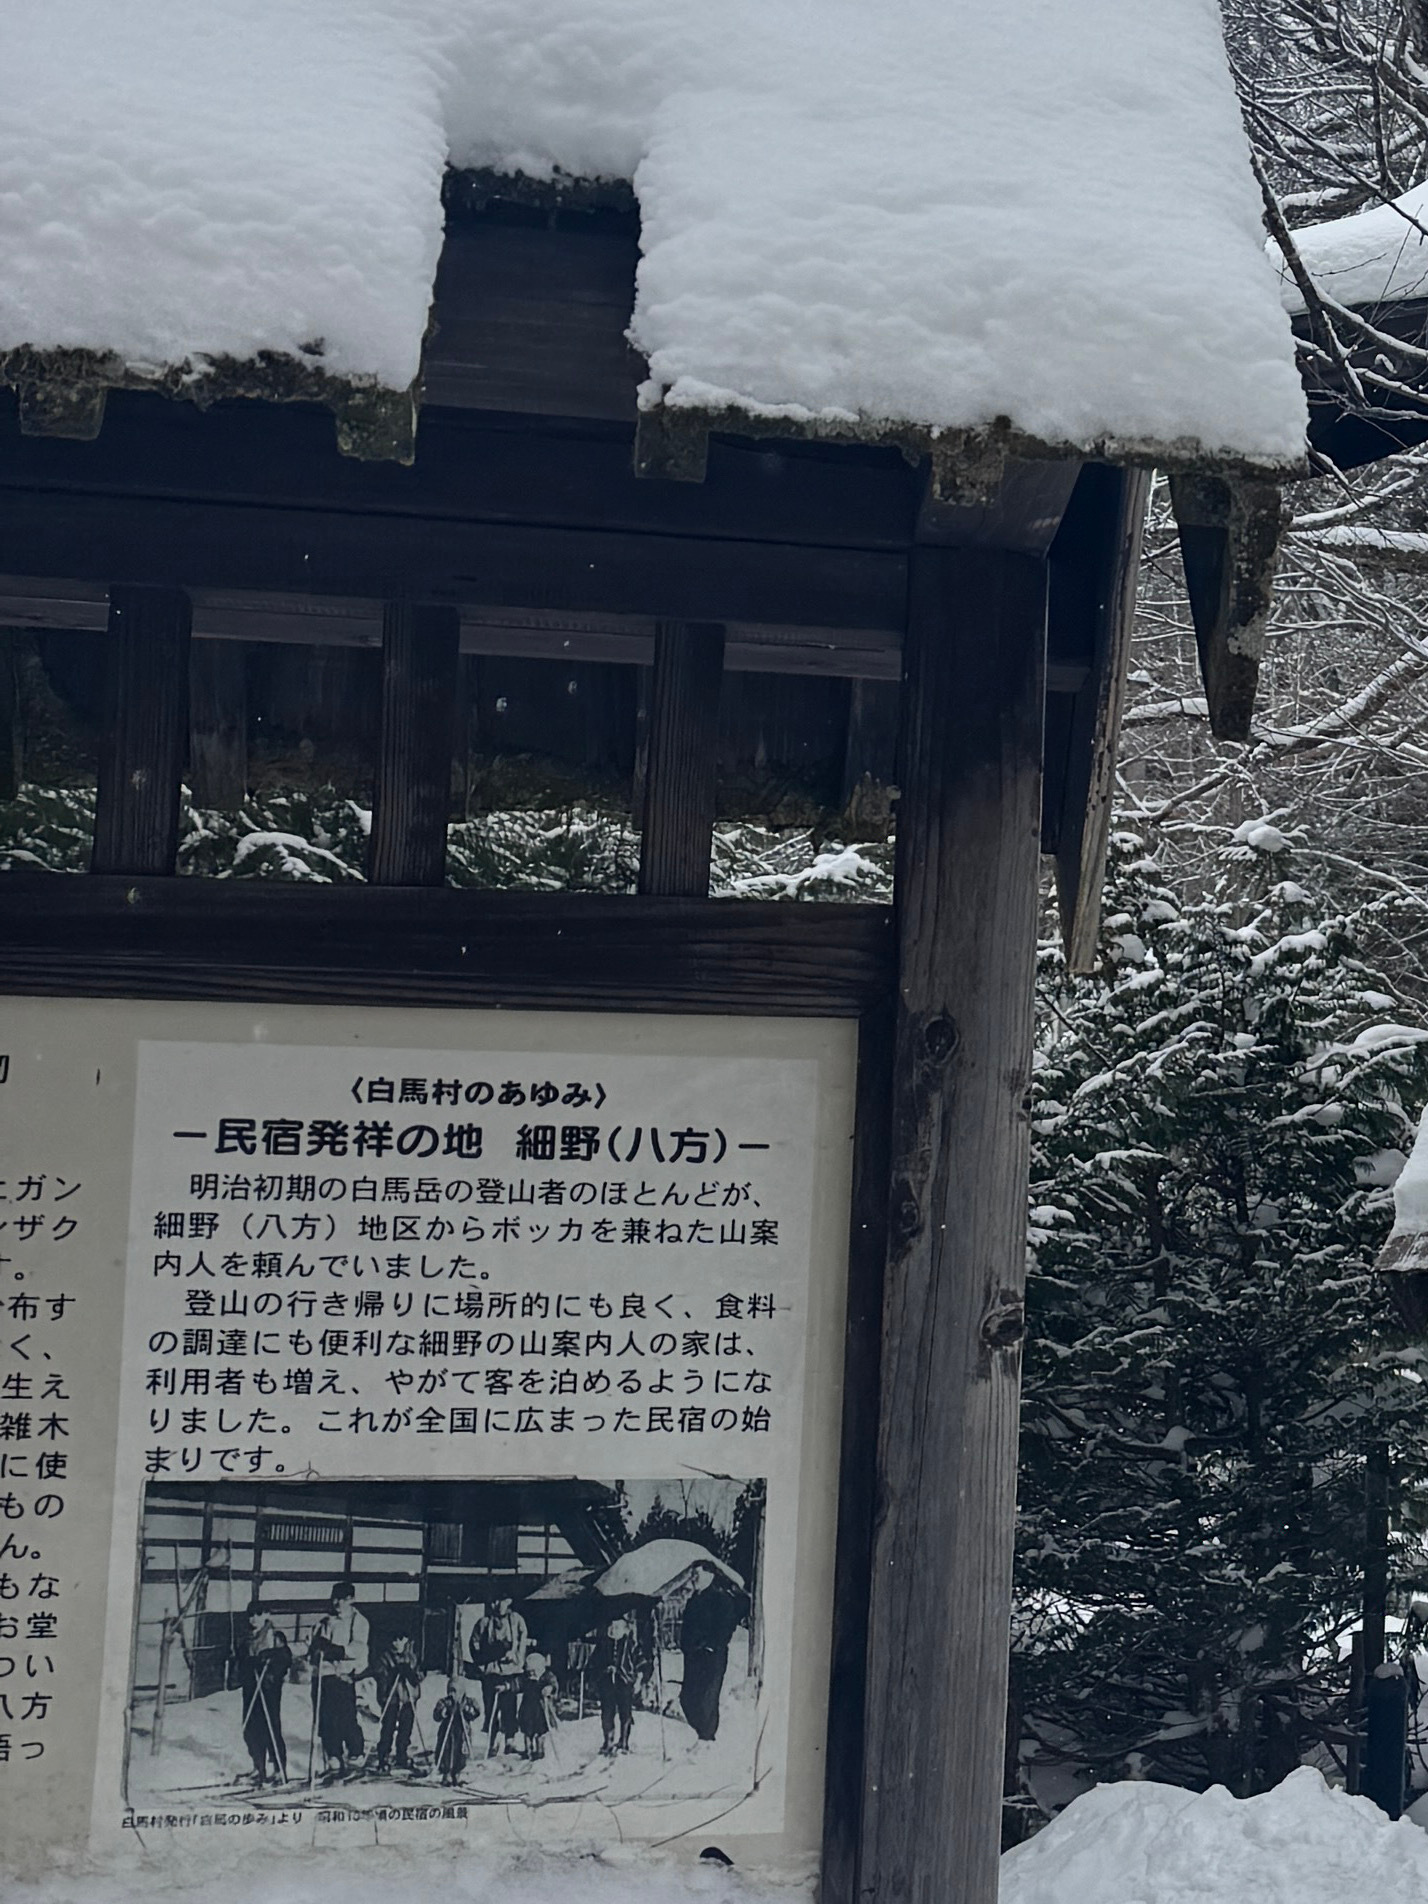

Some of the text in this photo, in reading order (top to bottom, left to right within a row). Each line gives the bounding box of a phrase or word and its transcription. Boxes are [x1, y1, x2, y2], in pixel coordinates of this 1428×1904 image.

[190, 1174, 763, 1208] 明治初期の白馬岳の登山者のほとんどが、
[153, 1211, 780, 1248] 細野（八方）地区からボッカを兼ねた山案
[152, 1251, 494, 1282] 内人を頼んでいました。
[0, 1292, 76, 1321] 布す
[184, 1289, 777, 1321] 登山の行き帰りに場所的にも良く、食料
[148, 1328, 759, 1359] の調達にも便利な細野の山案内人の家は、
[1, 1372, 70, 1400] 生え
[146, 1366, 773, 1398] 利用者も増え、やがて客を泊めるようにな
[147, 1404, 772, 1436] りました。これが全国に広まった民宿の始
[1, 1451, 68, 1480] に使
[145, 1444, 289, 1474] まりです。
